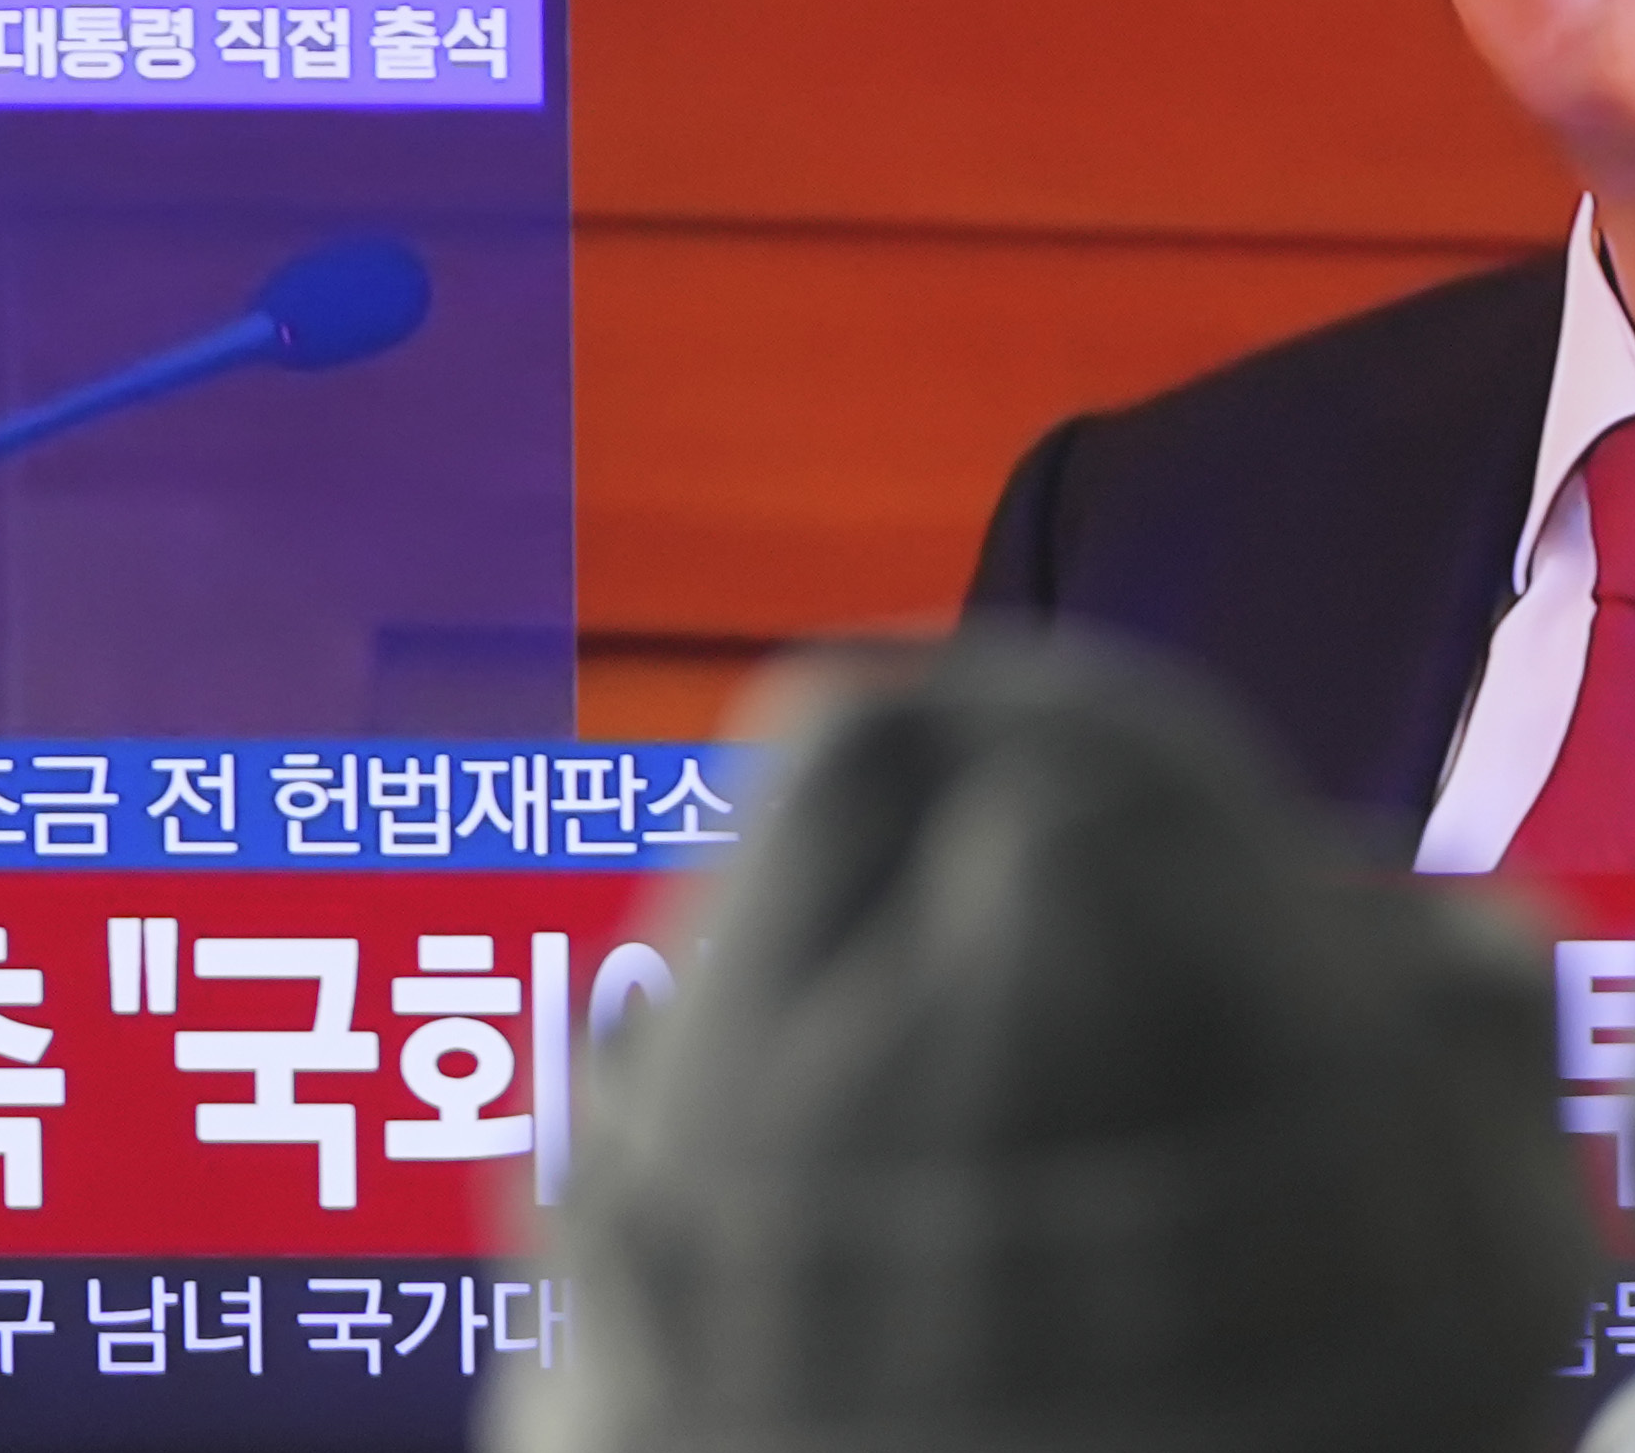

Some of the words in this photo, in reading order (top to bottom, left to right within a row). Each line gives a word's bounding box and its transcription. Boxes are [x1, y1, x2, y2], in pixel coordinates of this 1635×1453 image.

[214, 7, 351, 79] 직접
[369, 5, 508, 80] 출석
[146, 753, 239, 854] 전
[269, 753, 741, 857] 헌법재판소
[87, 1275, 263, 1375] 남녀
